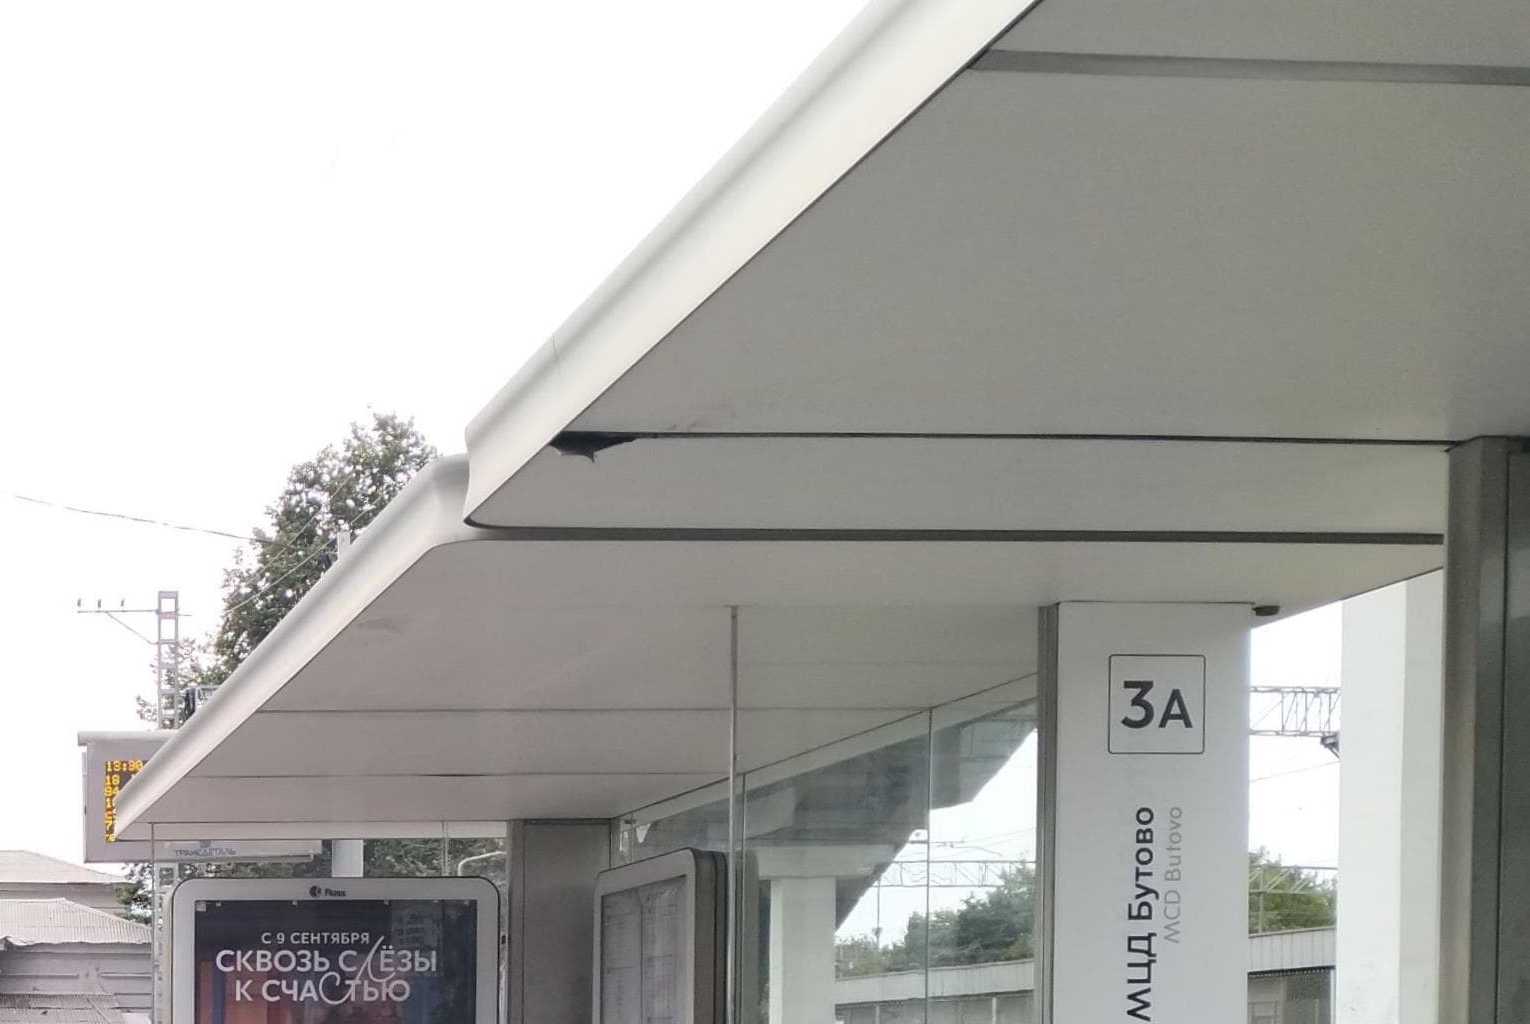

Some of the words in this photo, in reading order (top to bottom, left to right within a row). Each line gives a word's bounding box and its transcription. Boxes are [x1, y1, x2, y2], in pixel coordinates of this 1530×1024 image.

[1127, 807, 1159, 920] Бутово
[1164, 807, 1182, 881] Butovo
[261, 932, 272, 945] С
[276, 932, 285, 945] 9
[290, 932, 370, 945] СЕНТЯБРЯ
[1164, 889, 1181, 944] MCD
[216, 949, 330, 972] СКВОЗЬ
[1126, 932, 1157, 1022] МЦД
[235, 980, 254, 1001] К
[262, 972, 411, 1005] СЧАСТЬЮ
